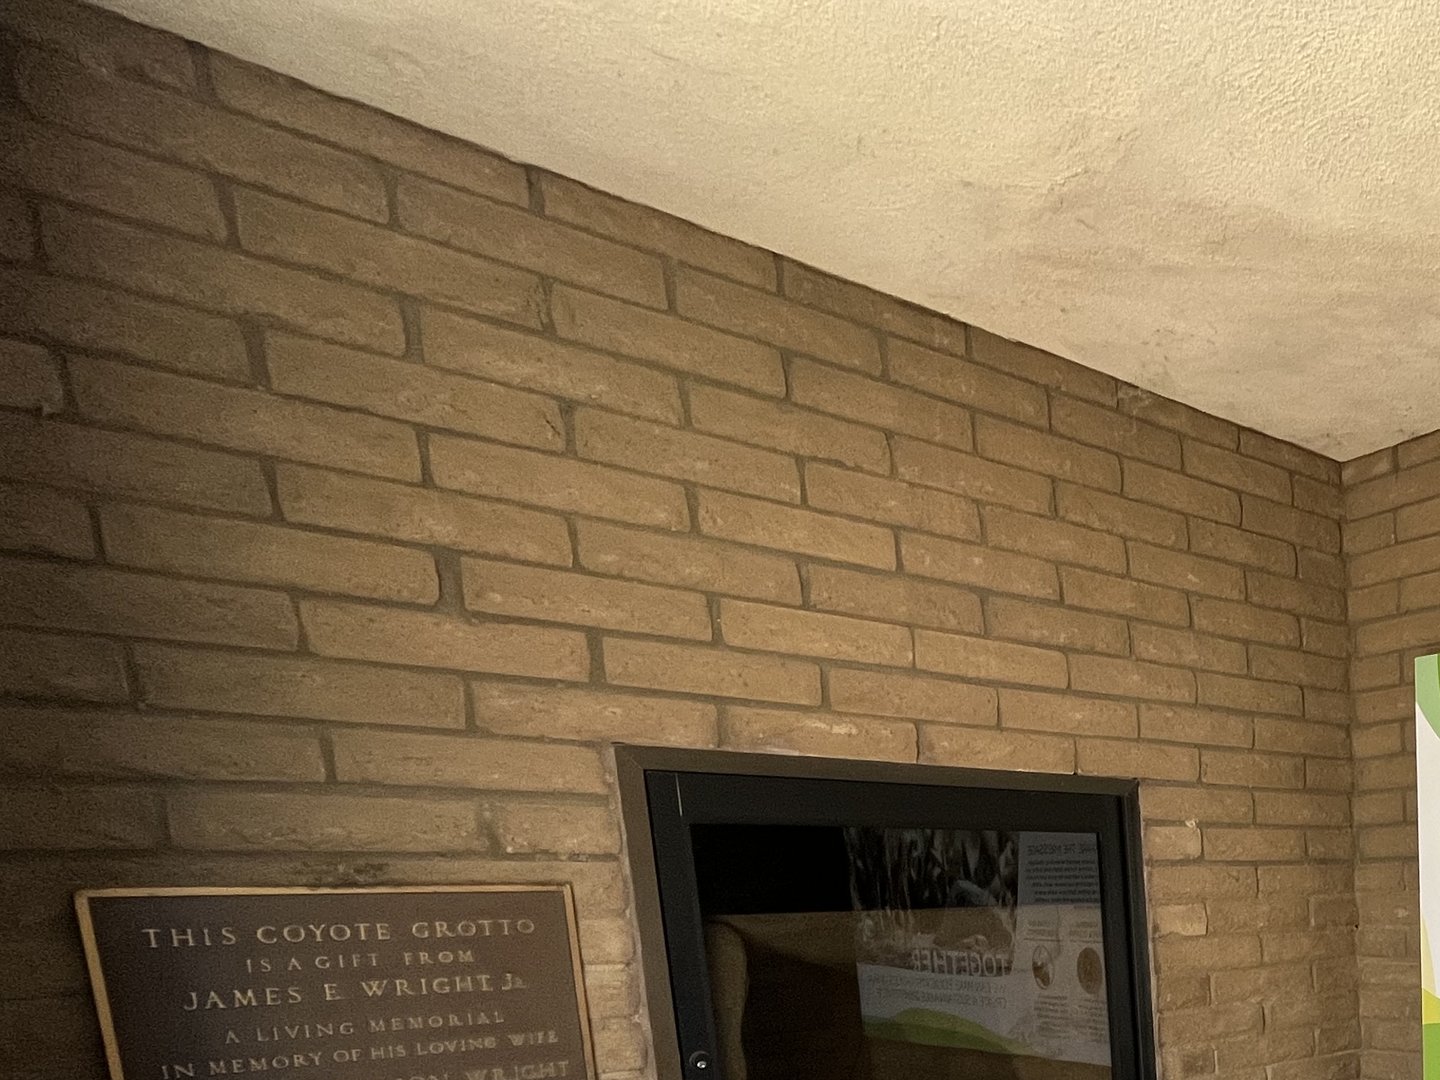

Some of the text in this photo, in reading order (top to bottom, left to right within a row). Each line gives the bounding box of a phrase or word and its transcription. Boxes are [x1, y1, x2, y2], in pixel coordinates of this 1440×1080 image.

[141, 918, 535, 947] THIS COYOTE GROTTO
[246, 949, 473, 972] IS A GIFT FROM
[181, 986, 302, 1010] JAMES
[322, 983, 342, 1001] E
[362, 974, 493, 999] WRIGHT
[224, 1010, 504, 1044] A LIVING MEMORIAL
[161, 1030, 558, 1079] IN MEMORY OF HIS LOVING WIFE
